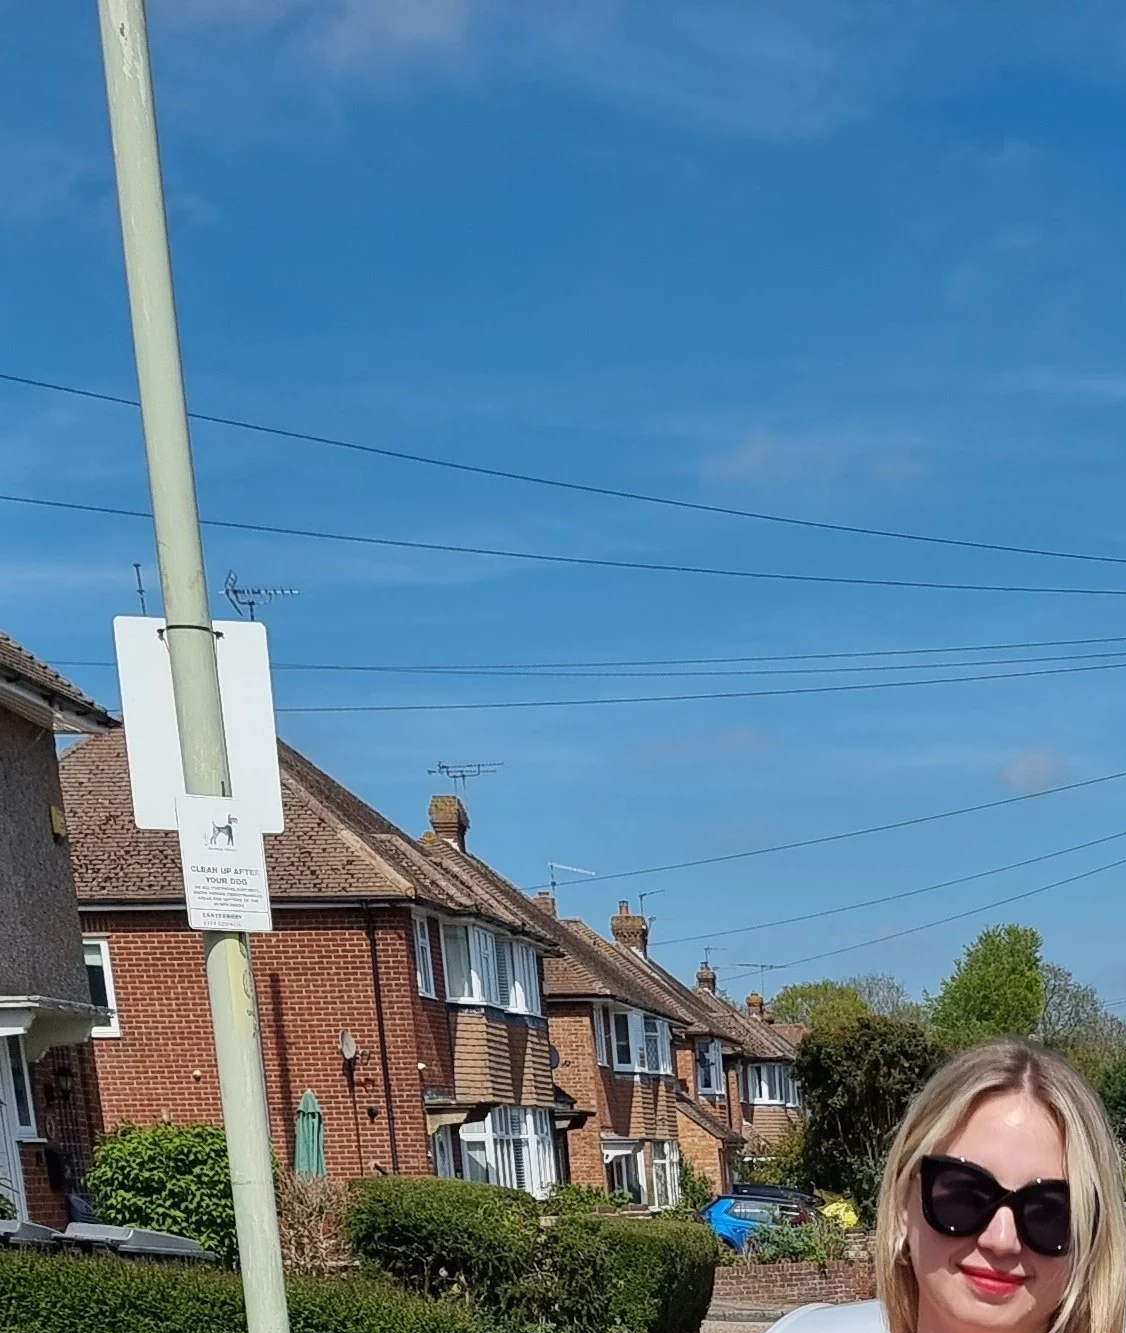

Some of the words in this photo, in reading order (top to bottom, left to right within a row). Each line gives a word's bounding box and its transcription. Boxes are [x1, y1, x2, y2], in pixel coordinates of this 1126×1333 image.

[190, 865, 218, 874] CLEAN
[220, 867, 232, 875] UP
[205, 876, 228, 885] YOUR
[229, 878, 248, 886] DOG
